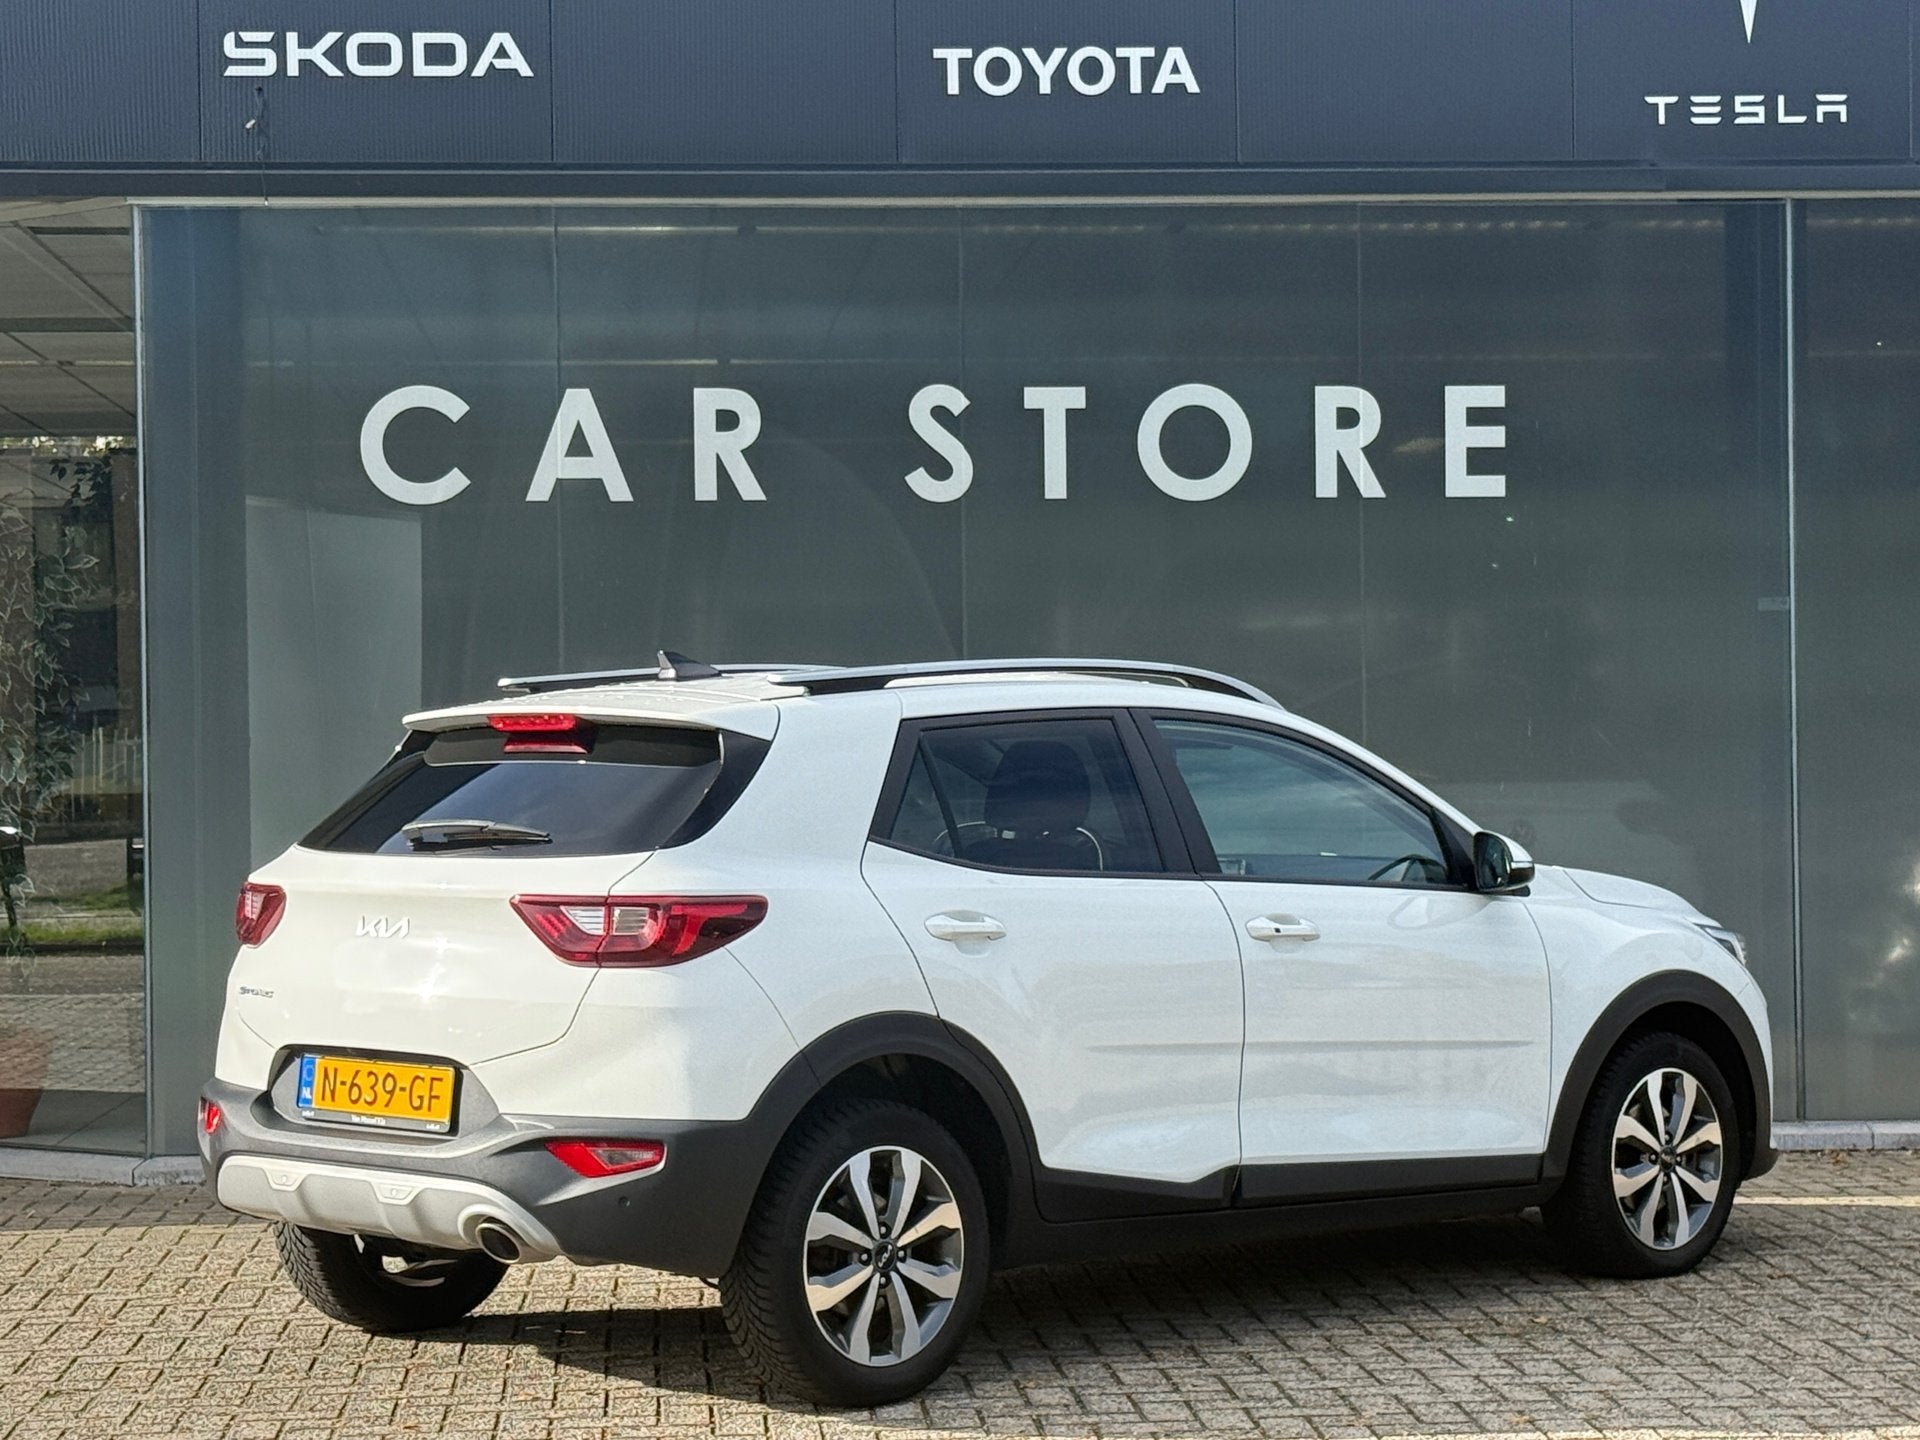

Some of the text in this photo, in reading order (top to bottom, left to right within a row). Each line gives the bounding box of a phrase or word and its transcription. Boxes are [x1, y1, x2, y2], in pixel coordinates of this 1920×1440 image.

[932, 46, 1201, 96] TOYOTA
[1644, 94, 1848, 125] TESLA
[360, 383, 1506, 505] CAR STORE
[301, 1086, 313, 1100] NL
[320, 1066, 445, 1113] N-639-GF
